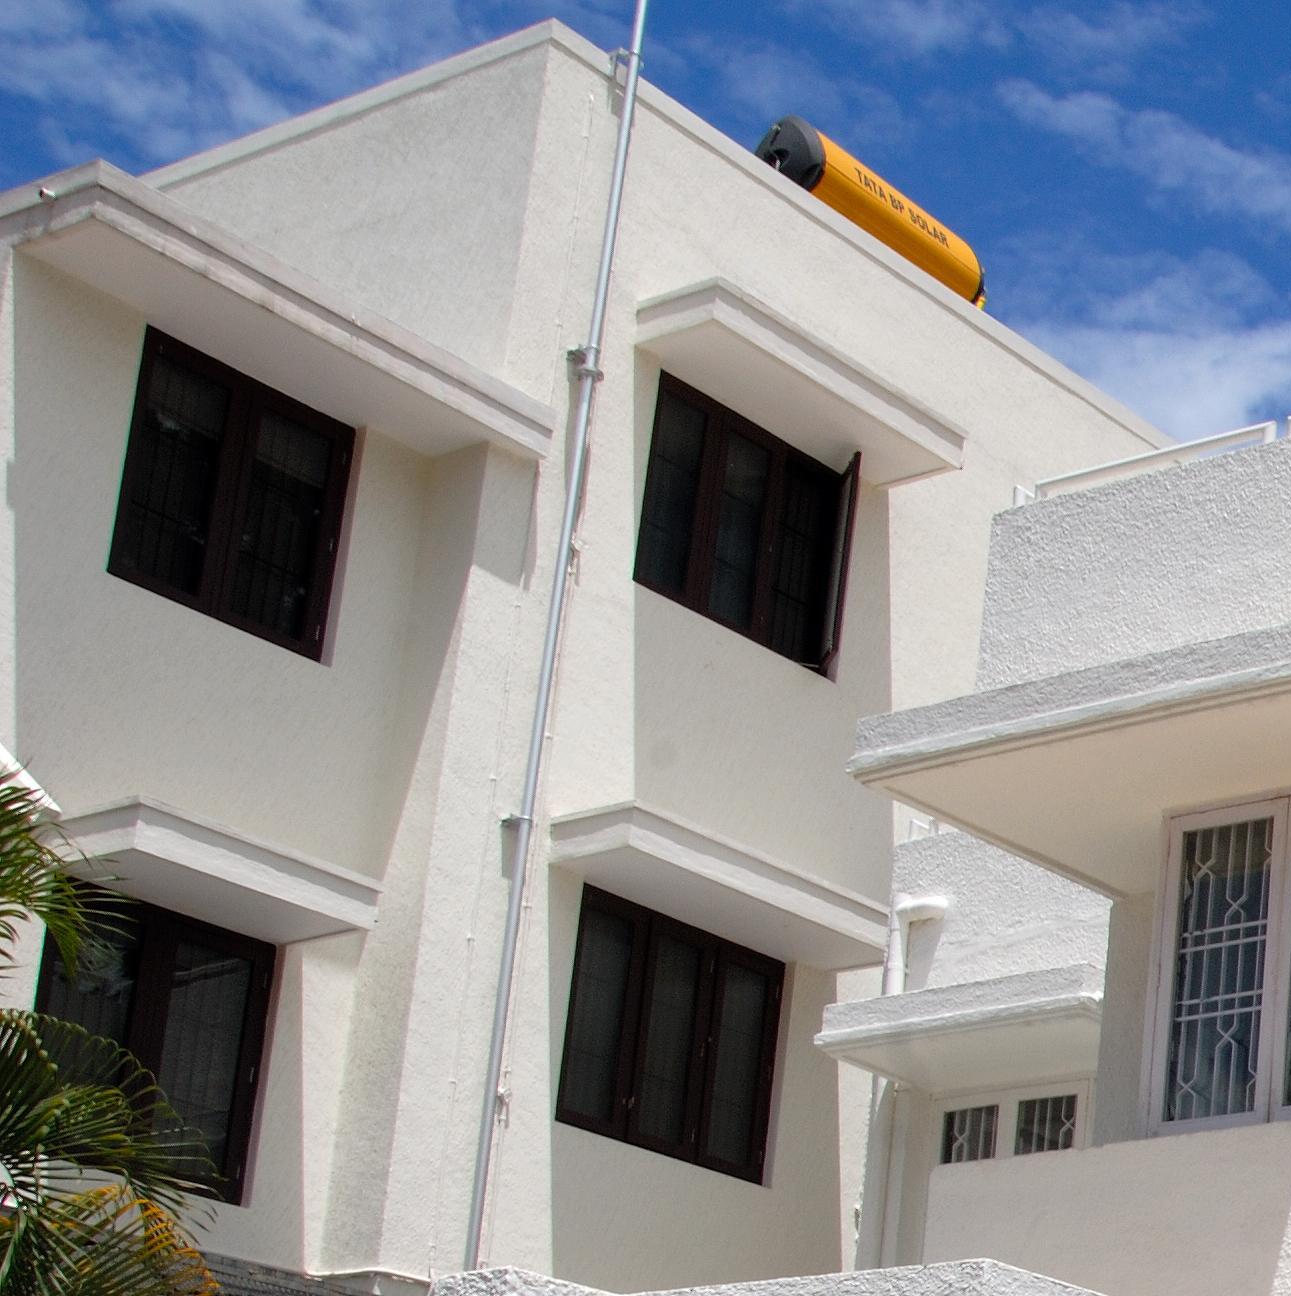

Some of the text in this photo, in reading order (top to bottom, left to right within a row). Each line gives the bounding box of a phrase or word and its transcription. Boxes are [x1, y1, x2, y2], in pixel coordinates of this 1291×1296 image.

[854, 168, 949, 248] TATA BP SOLAR
